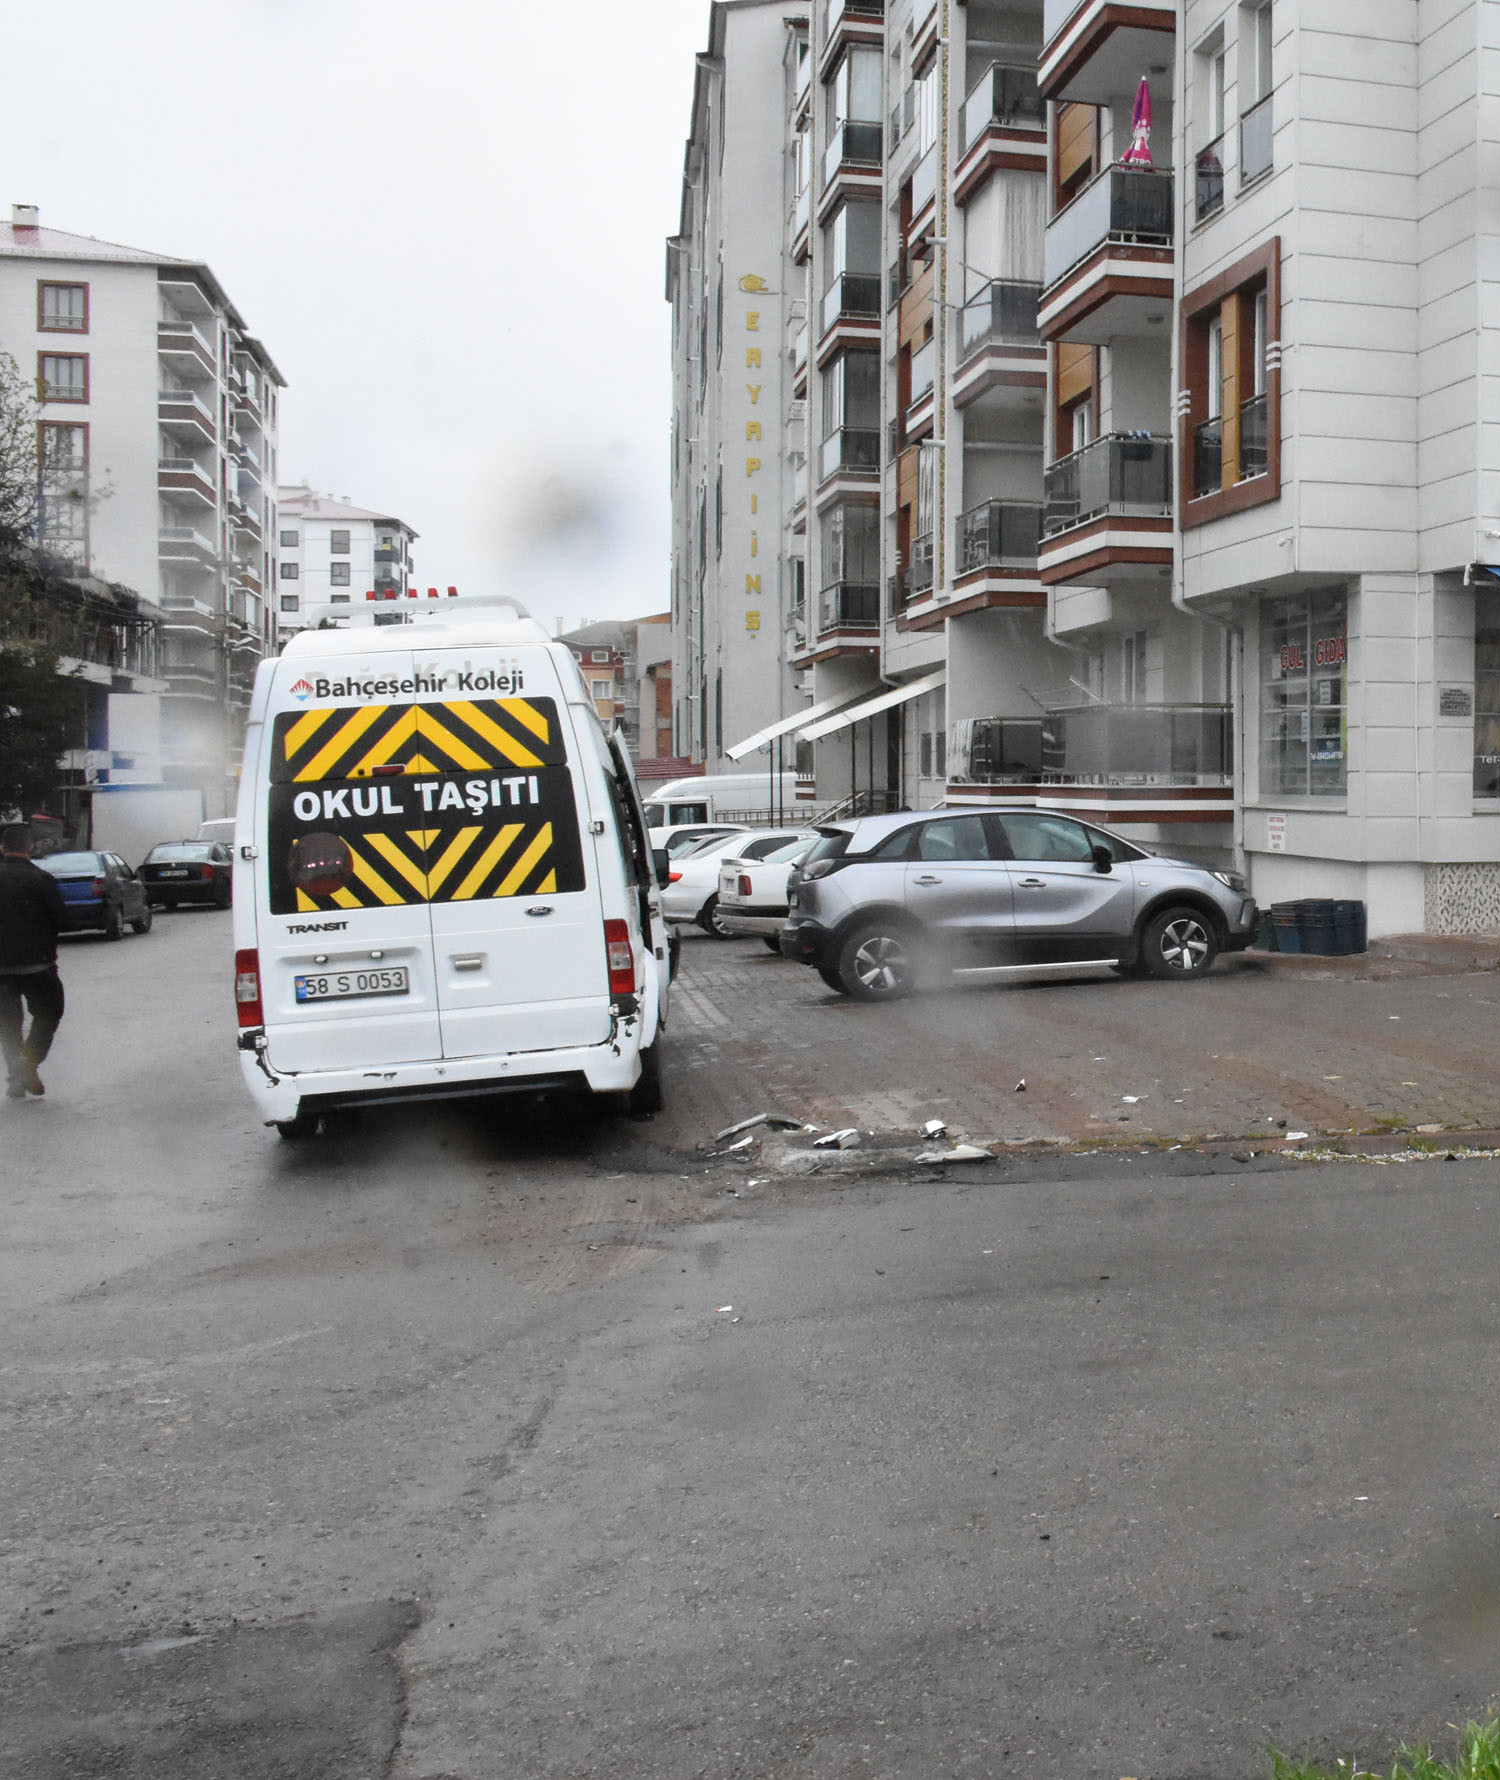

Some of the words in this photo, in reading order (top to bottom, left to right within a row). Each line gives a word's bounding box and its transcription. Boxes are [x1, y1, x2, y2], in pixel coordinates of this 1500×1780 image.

[1281, 639, 1304, 670] GÜL
[1315, 636, 1346, 666] GIDA
[315, 673, 447, 700] Bahçeşehir
[458, 670, 524, 695] Koleji
[293, 785, 404, 821] OKUL
[414, 775, 540, 816] TAŞITI
[286, 921, 349, 935] TRANSIT
[306, 977, 328, 995] 58
[338, 976, 350, 993] S
[357, 972, 404, 991] 0053
